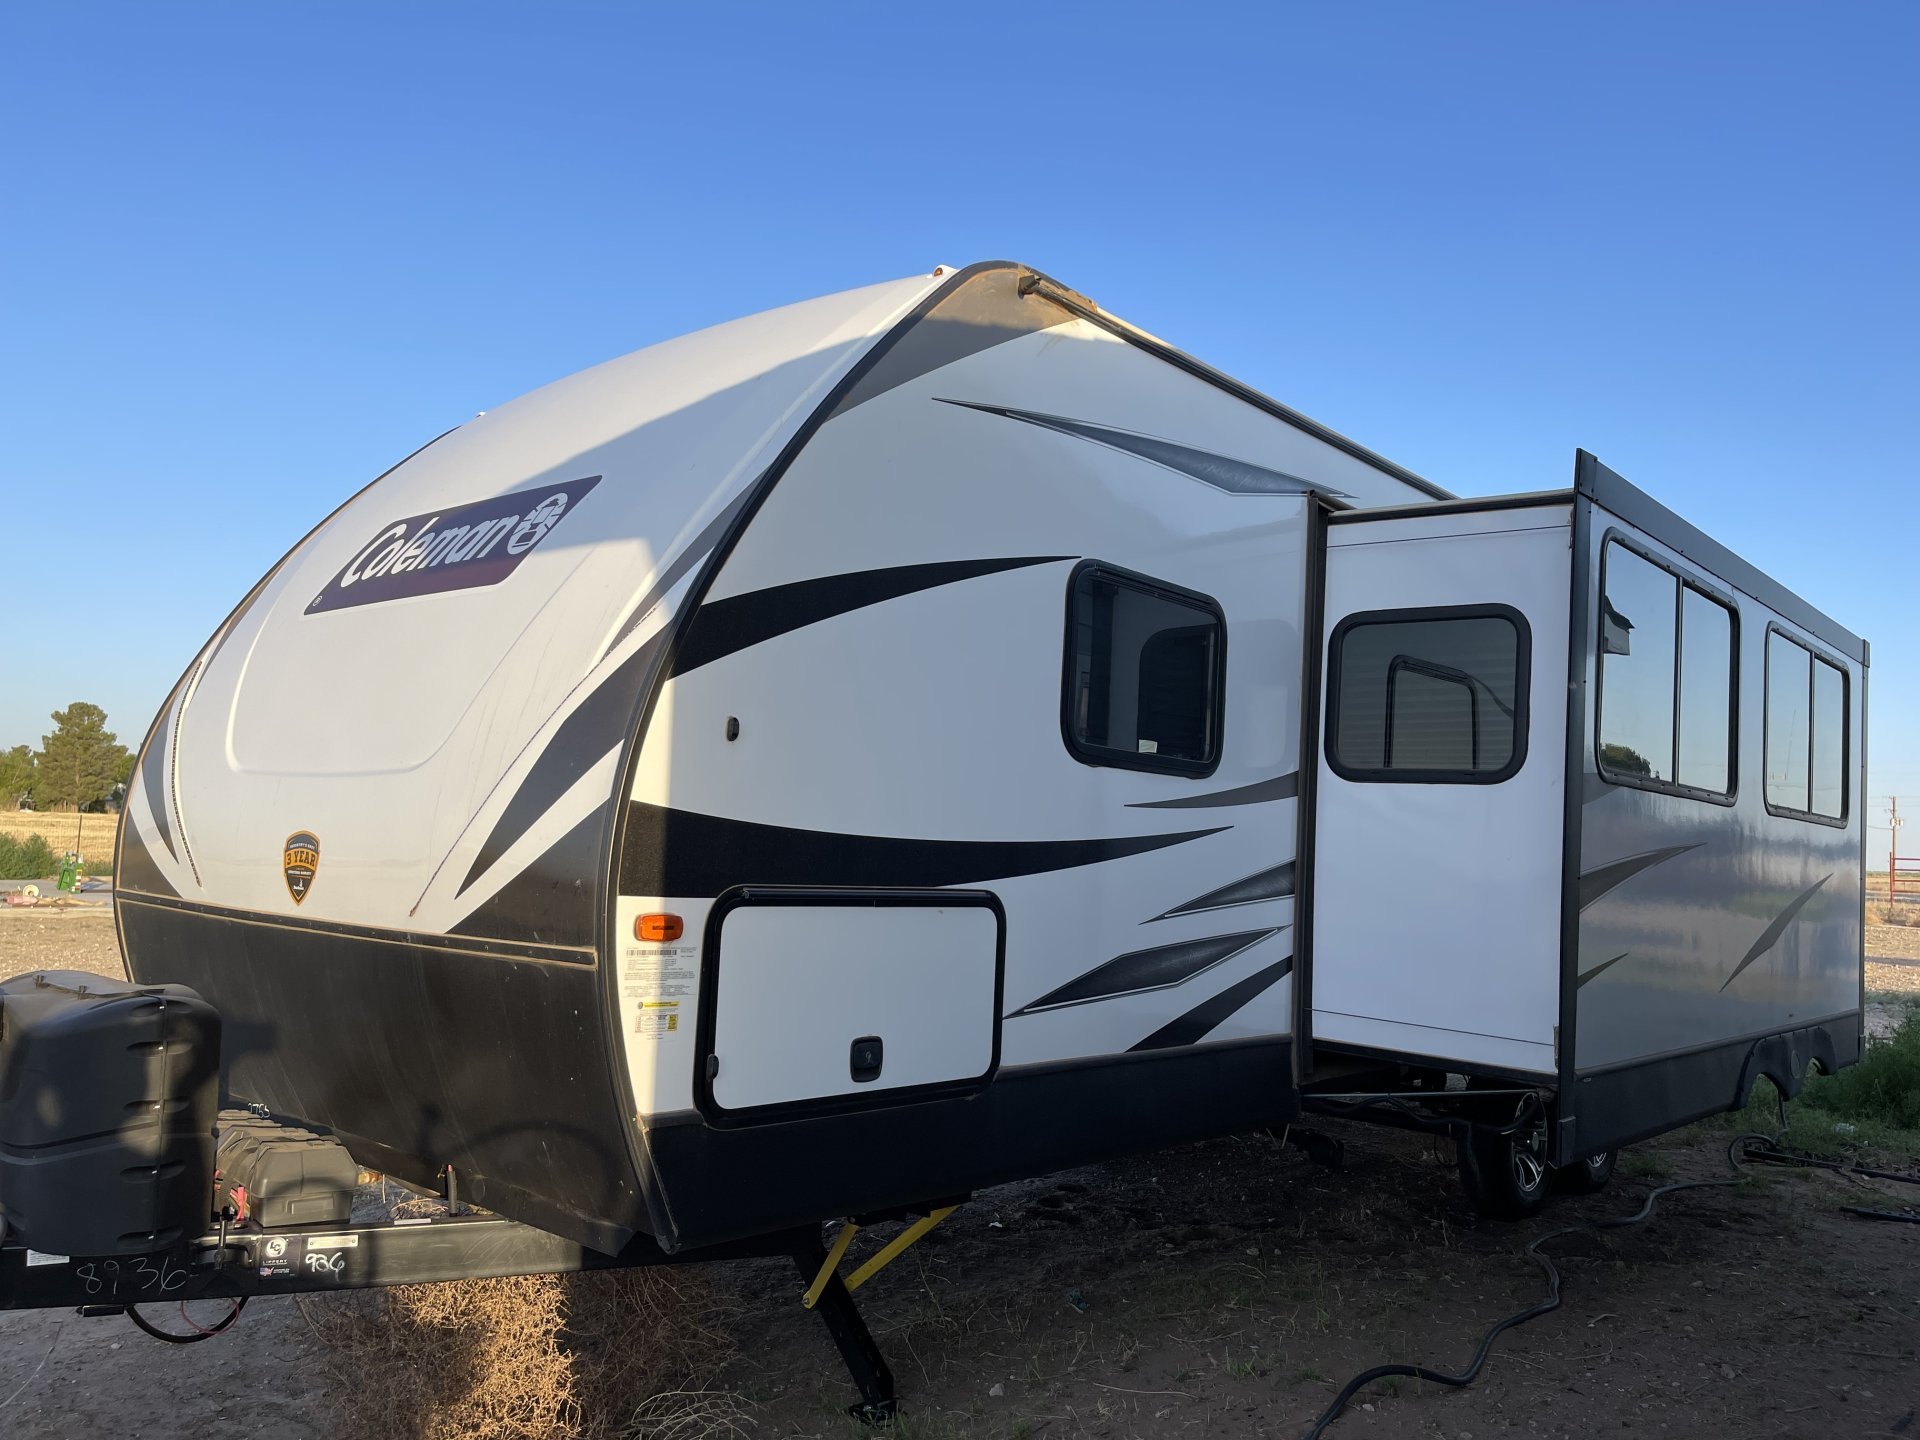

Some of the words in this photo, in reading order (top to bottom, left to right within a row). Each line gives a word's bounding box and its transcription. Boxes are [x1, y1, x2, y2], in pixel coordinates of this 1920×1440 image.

[340, 516, 520, 588] Coleman
[286, 852, 292, 865] 3
[294, 850, 316, 867] YEAR
[76, 1256, 187, 1295] 8936
